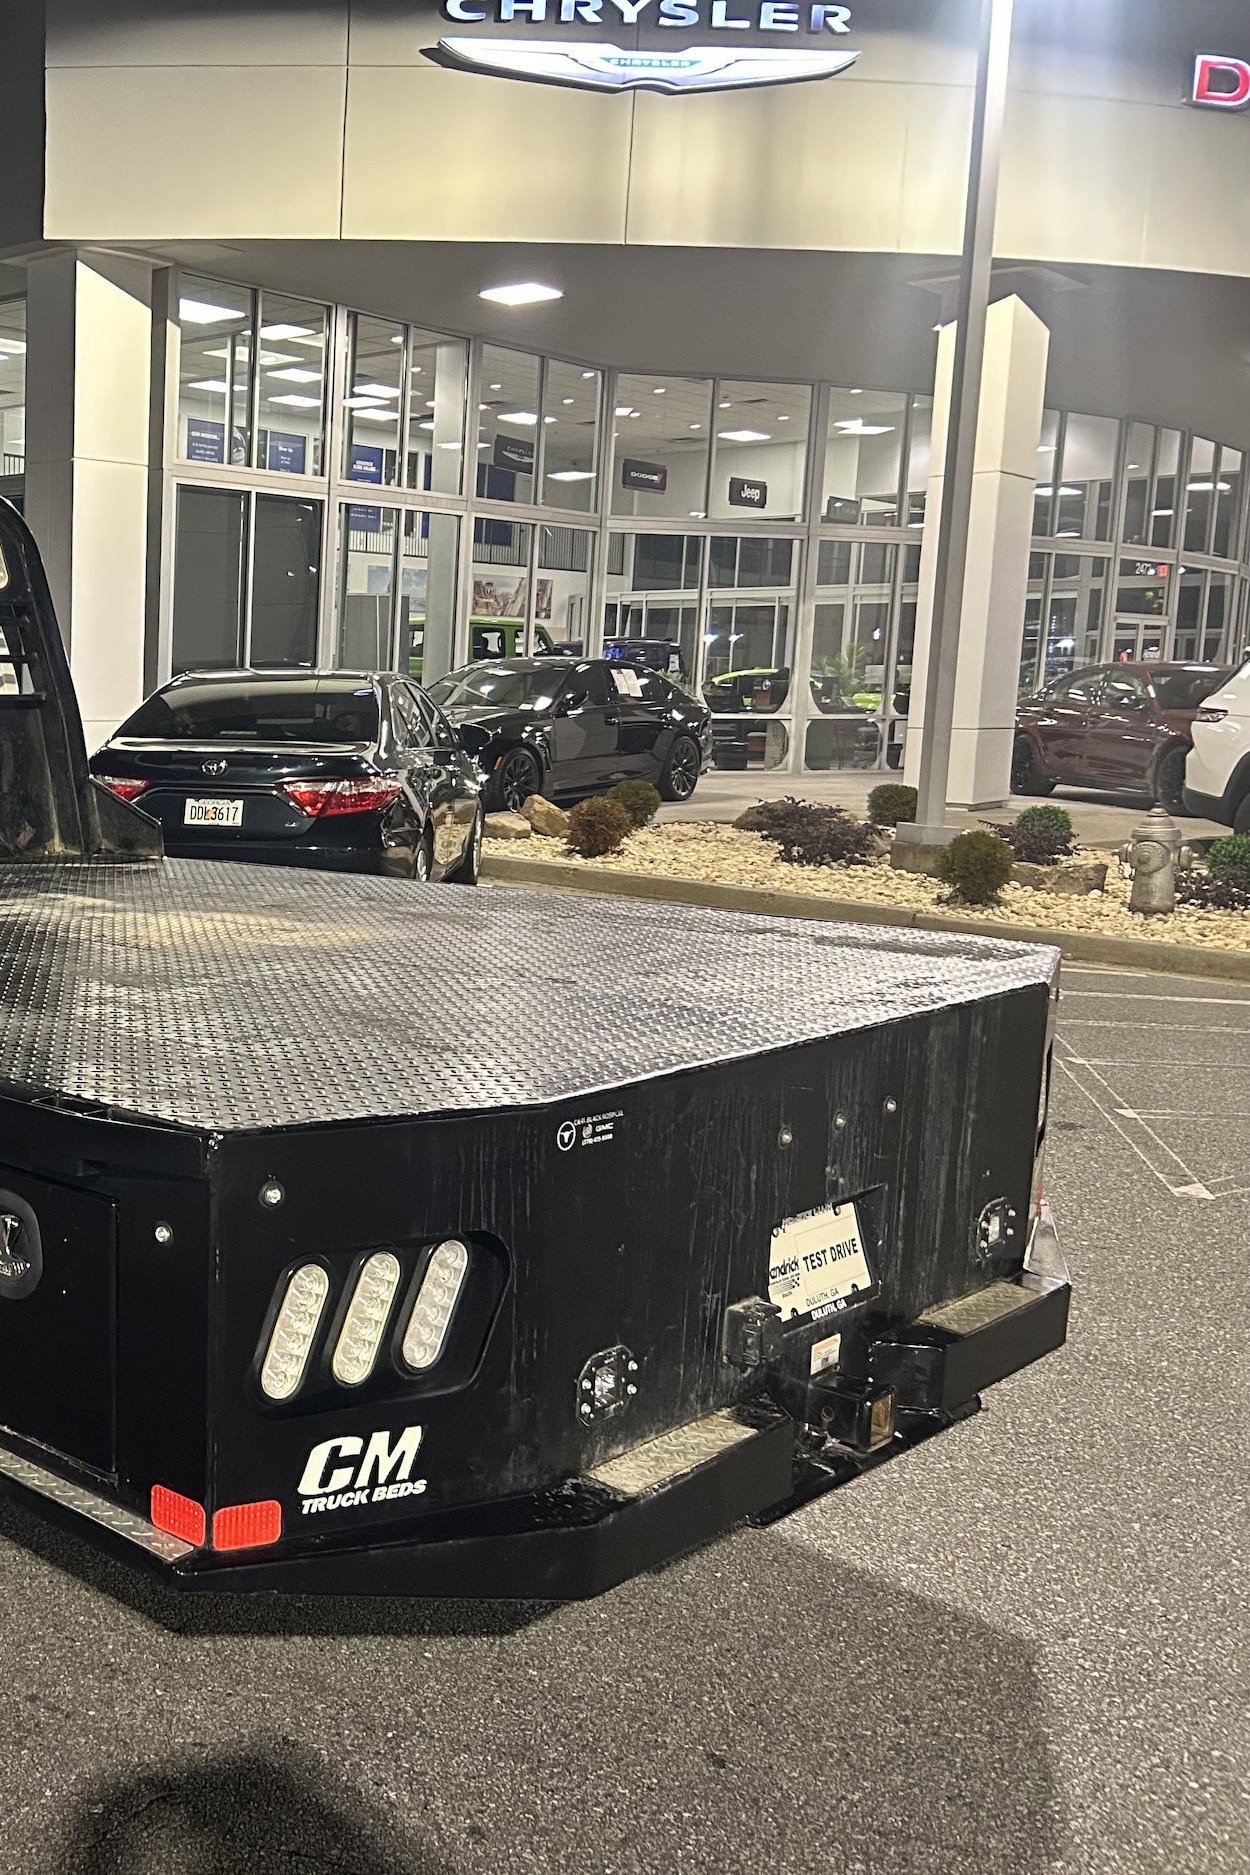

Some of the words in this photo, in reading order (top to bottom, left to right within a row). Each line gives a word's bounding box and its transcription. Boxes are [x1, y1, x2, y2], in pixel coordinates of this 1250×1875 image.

[447, 0, 851, 34] CHRYSLER
[609, 57, 691, 68] CHRYSLER
[630, 471, 659, 481] DODGE
[741, 484, 760, 501] Jeep
[595, 1122, 614, 1132] GMC
[802, 1249, 829, 1272] TEST
[829, 1238, 858, 1262] DRIVE
[830, 1287, 840, 1297] GA
[836, 1299, 847, 1310] GA
[297, 1425, 422, 1496] CM
[301, 1488, 370, 1515] TRUCK
[371, 1479, 428, 1503] BEDS
